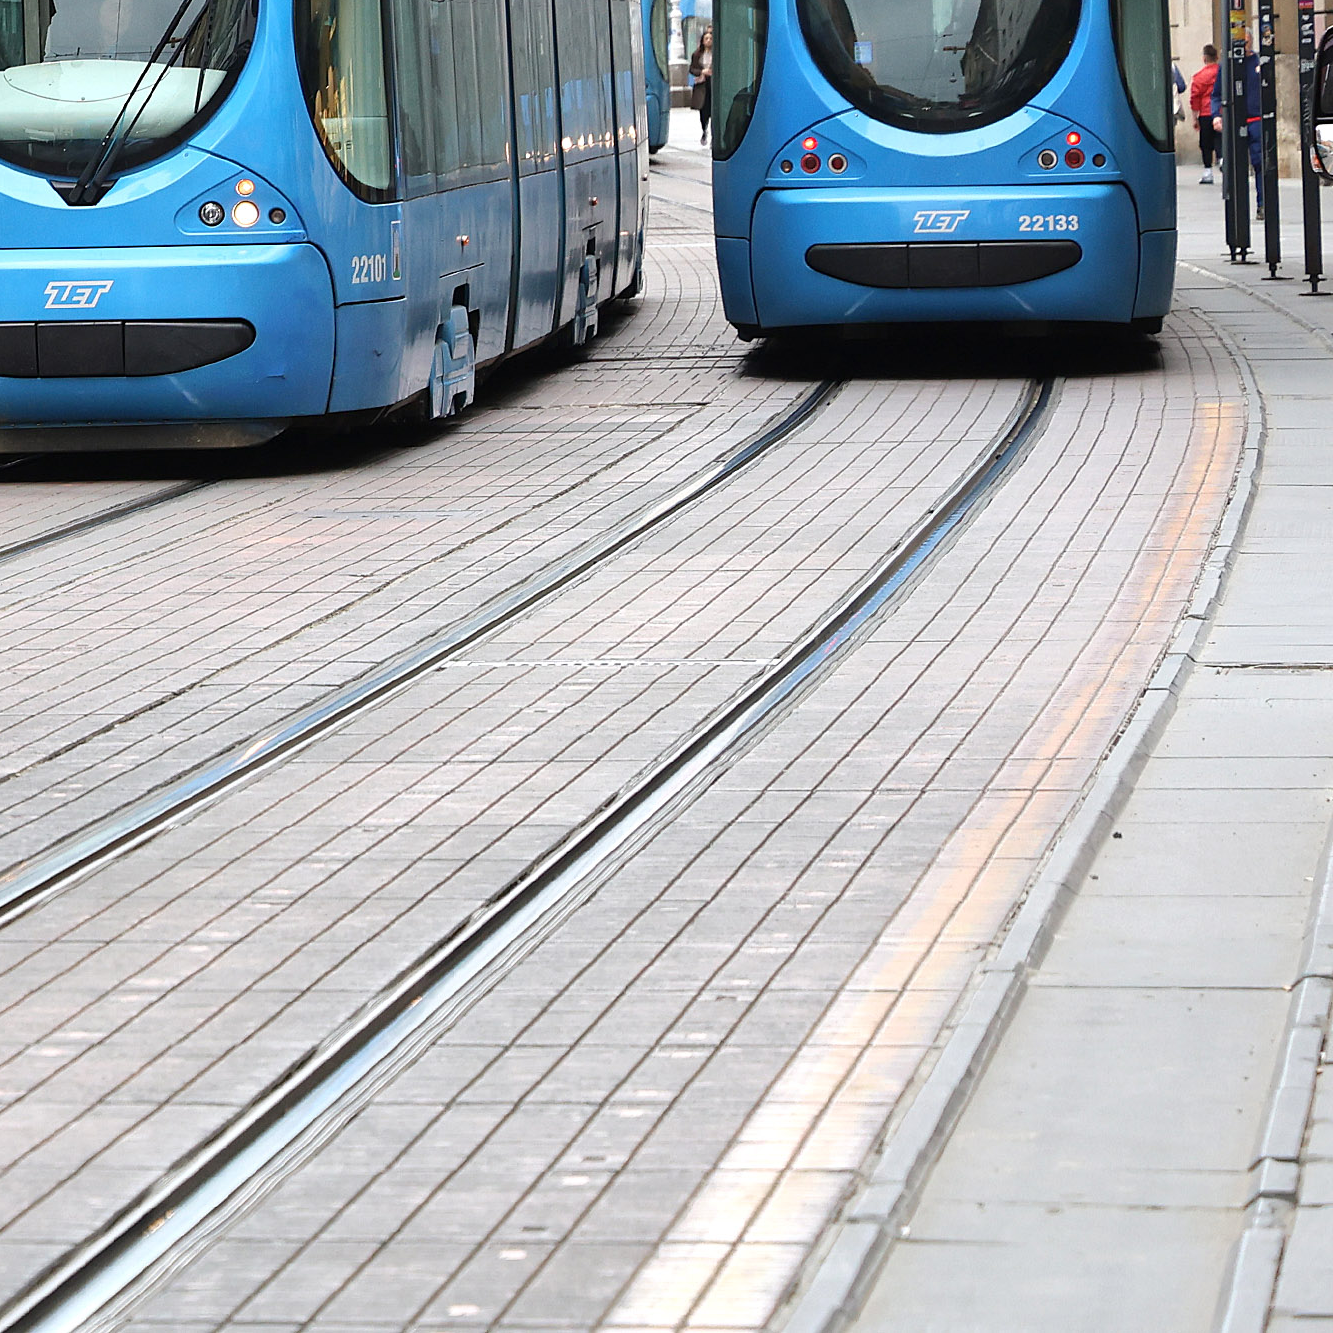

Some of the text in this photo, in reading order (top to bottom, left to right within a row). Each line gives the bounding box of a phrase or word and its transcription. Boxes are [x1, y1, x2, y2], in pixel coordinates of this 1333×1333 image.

[913, 210, 971, 233] ZET
[1018, 215, 1079, 232] 22133
[351, 253, 387, 284] 22101
[43, 280, 114, 309] ZET
